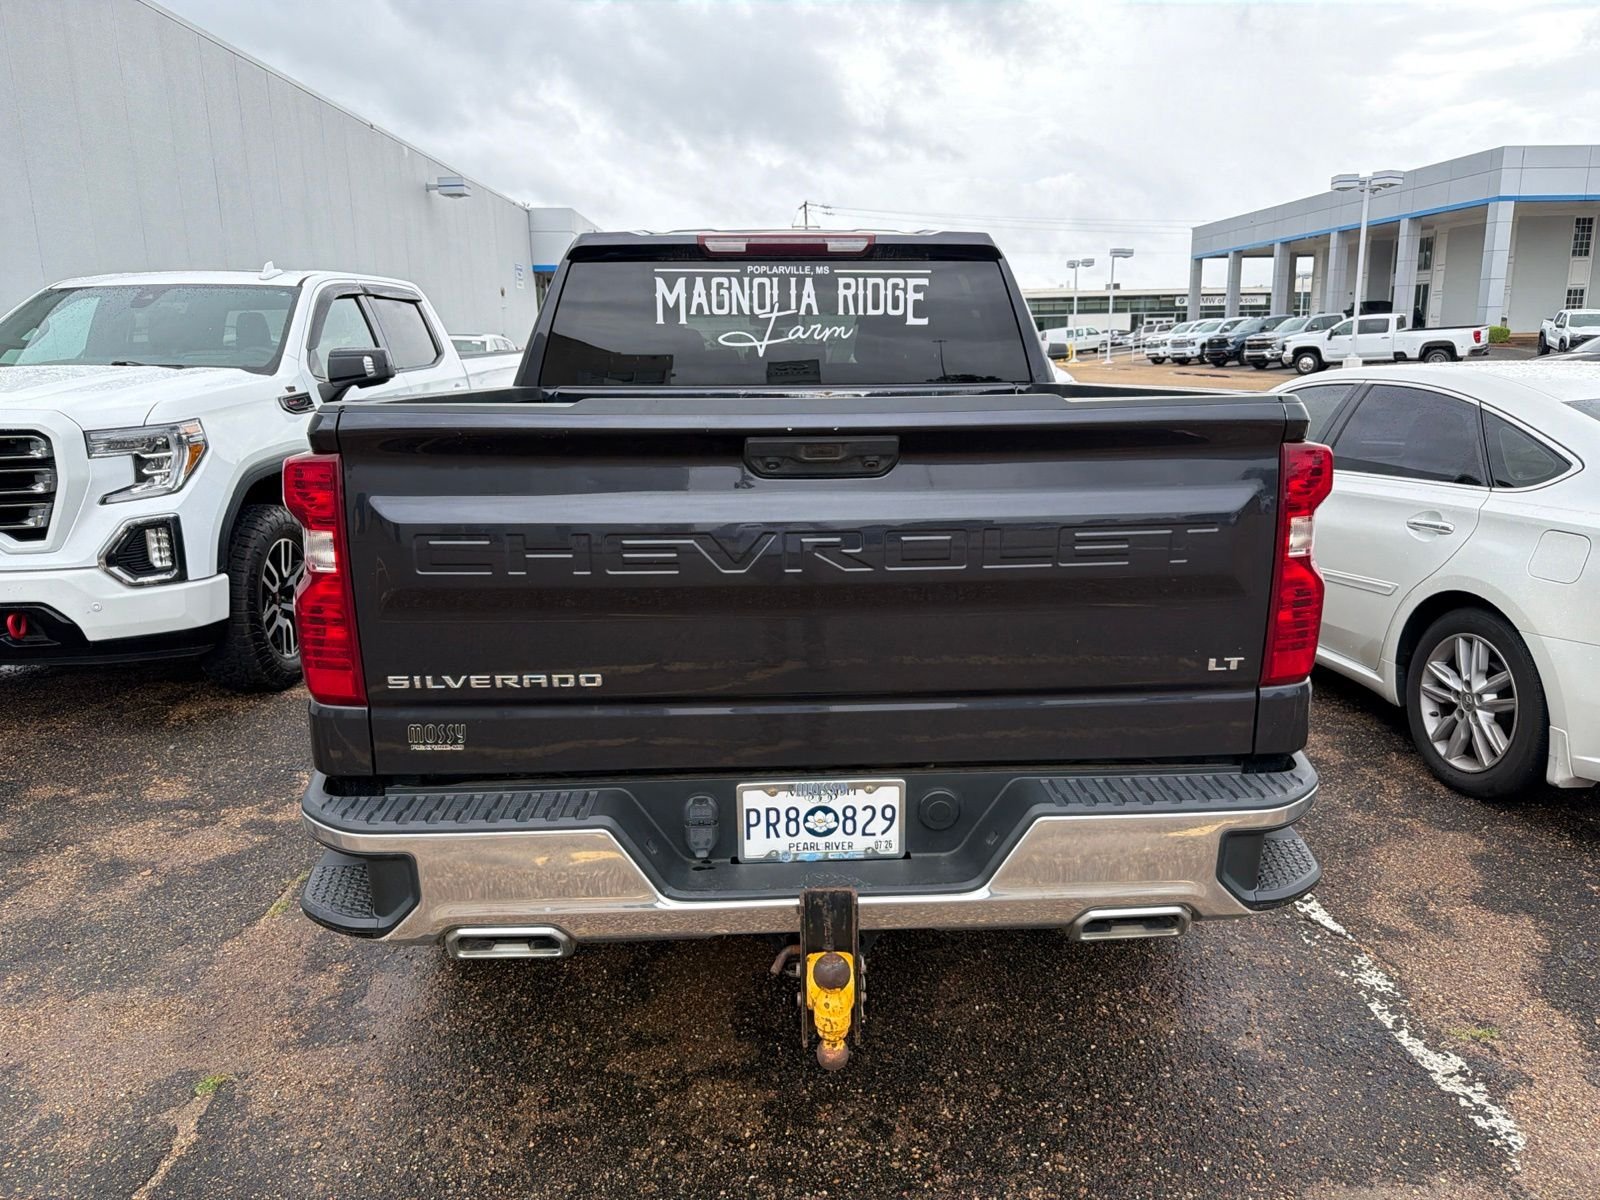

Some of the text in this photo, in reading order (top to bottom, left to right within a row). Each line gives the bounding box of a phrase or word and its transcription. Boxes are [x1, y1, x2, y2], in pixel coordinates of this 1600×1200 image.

[747, 266, 830, 275] POPLARVILLE, MS
[655, 277, 929, 325] MAGNOLIA RIDGE
[717, 302, 853, 357] Farm
[413, 521, 1219, 575] CHEVROLET
[1208, 657, 1245, 671] LT
[387, 673, 603, 689] SILVERADO
[788, 840, 854, 852] PEARL RIVER
